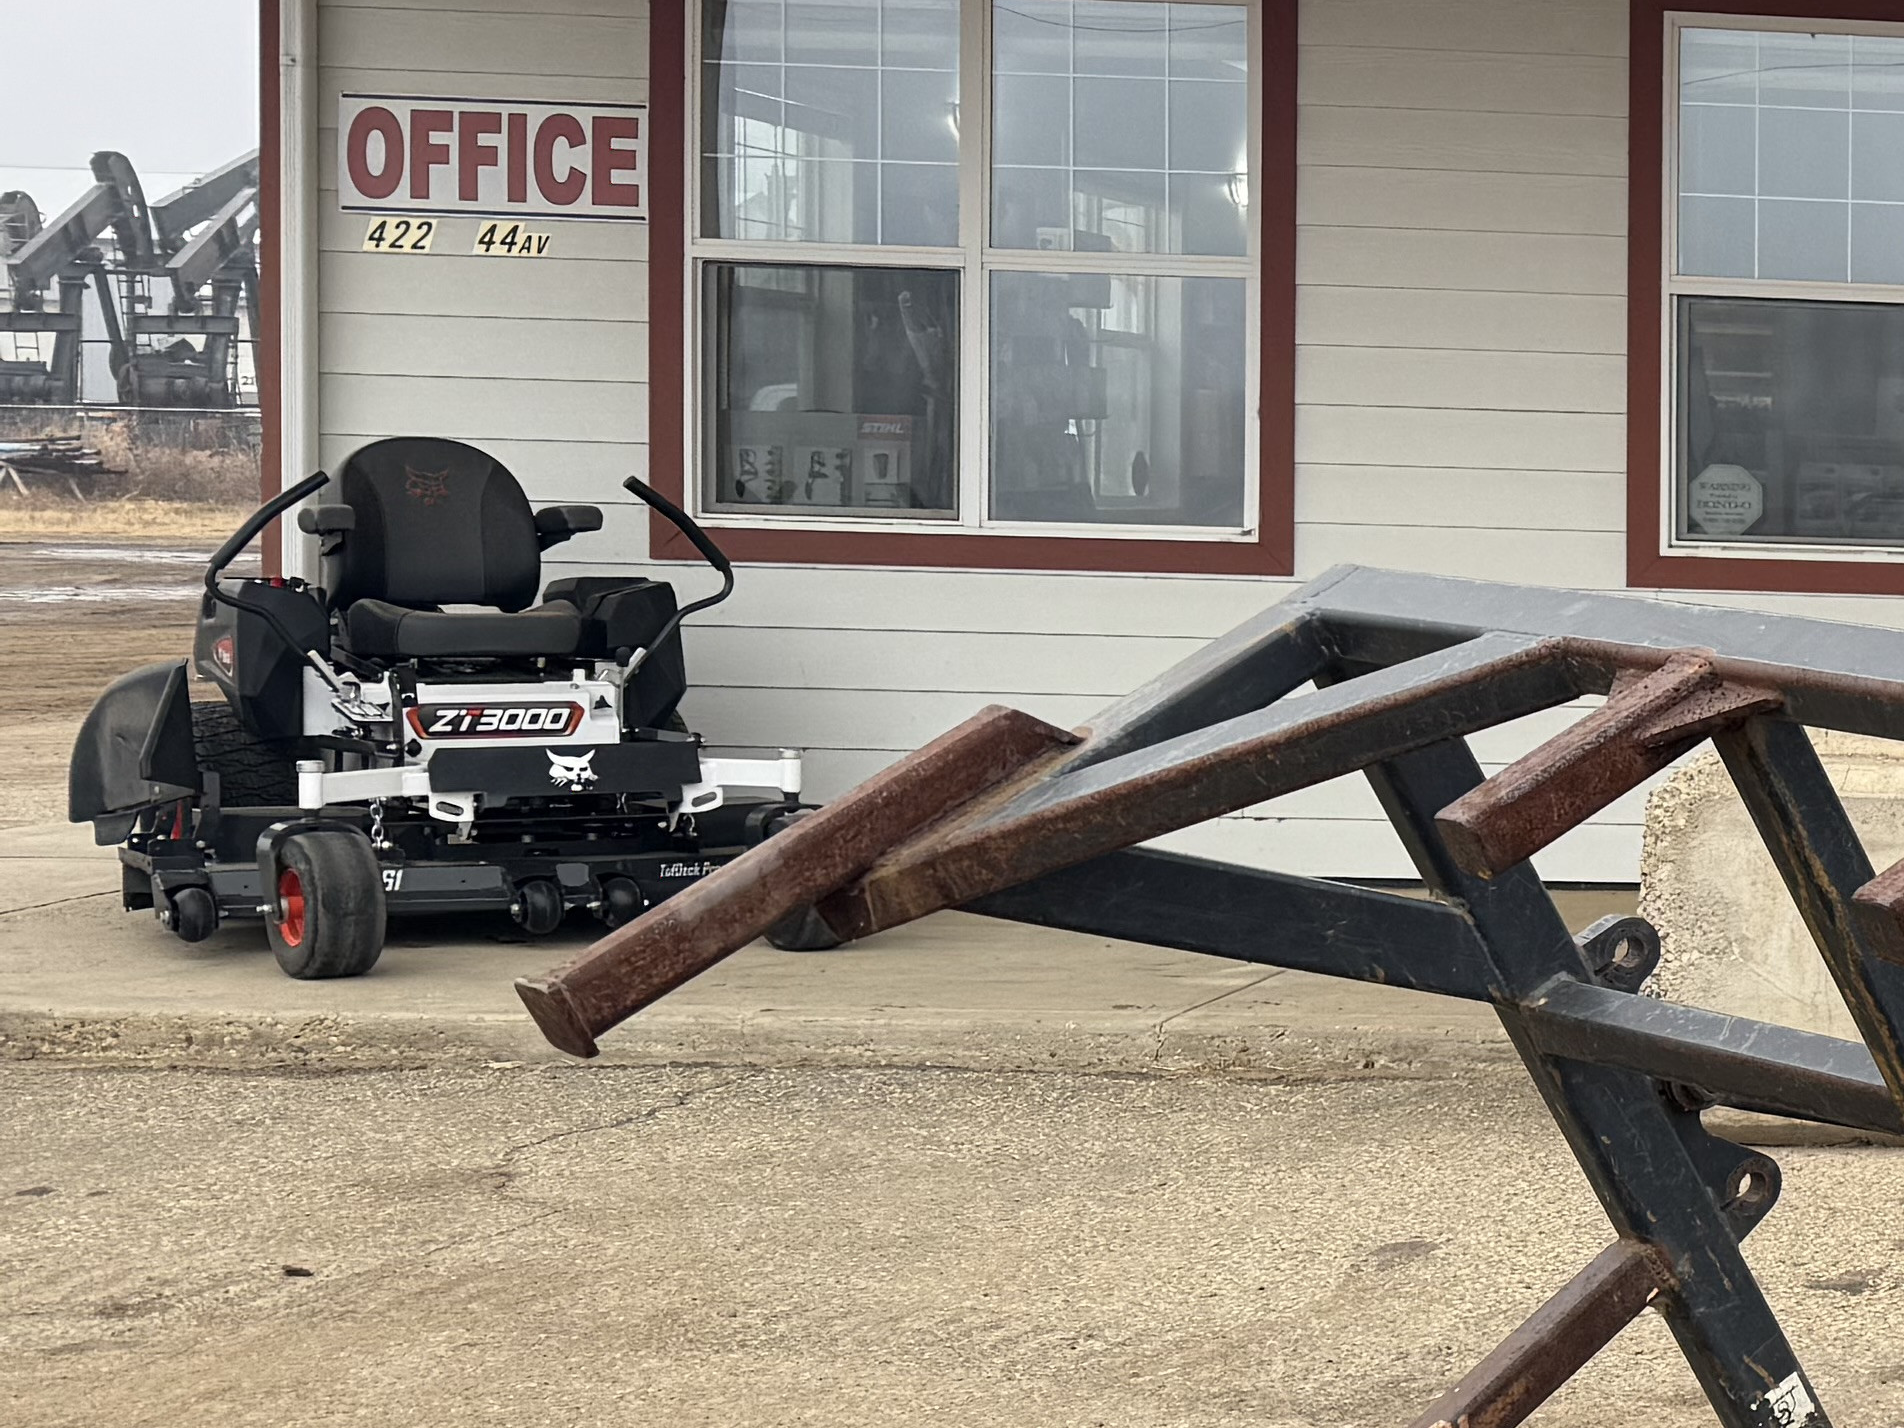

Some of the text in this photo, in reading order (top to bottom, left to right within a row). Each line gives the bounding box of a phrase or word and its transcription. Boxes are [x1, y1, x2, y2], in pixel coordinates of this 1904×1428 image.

[346, 105, 640, 208] OFFICE
[367, 219, 434, 251] 422
[428, 707, 572, 733] ZT3000
